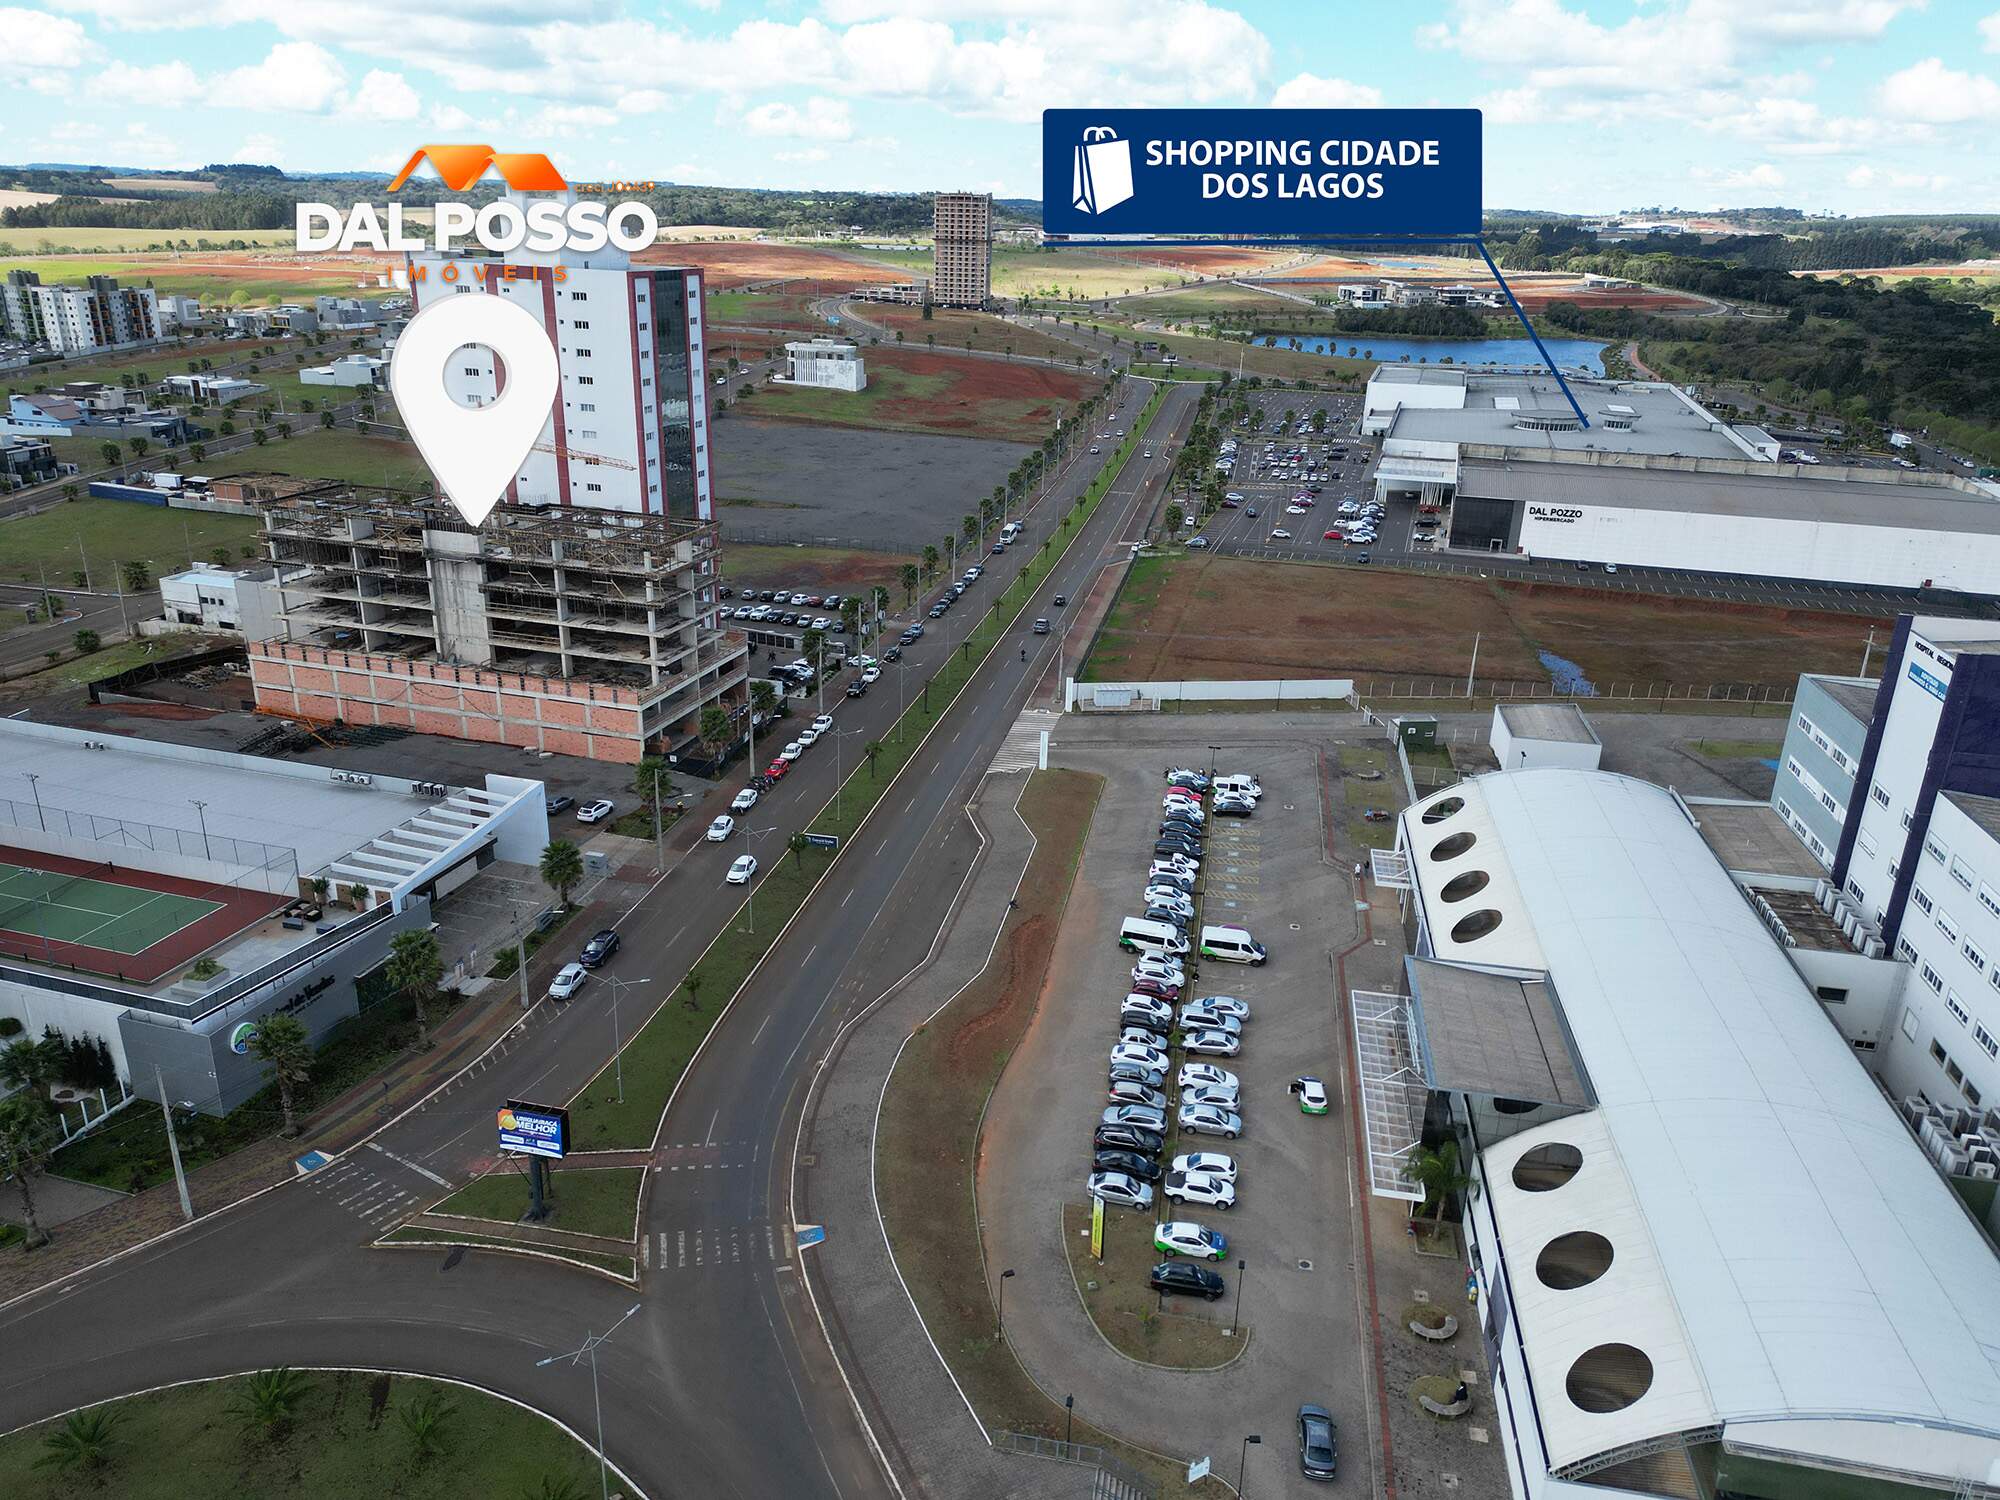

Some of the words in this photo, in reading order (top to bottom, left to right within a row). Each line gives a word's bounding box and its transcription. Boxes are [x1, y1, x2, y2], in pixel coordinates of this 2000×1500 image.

[1529, 506, 1547, 516] DAL
[1550, 508, 1583, 518] POZZO
[517, 1121, 557, 1135] MELHOR
